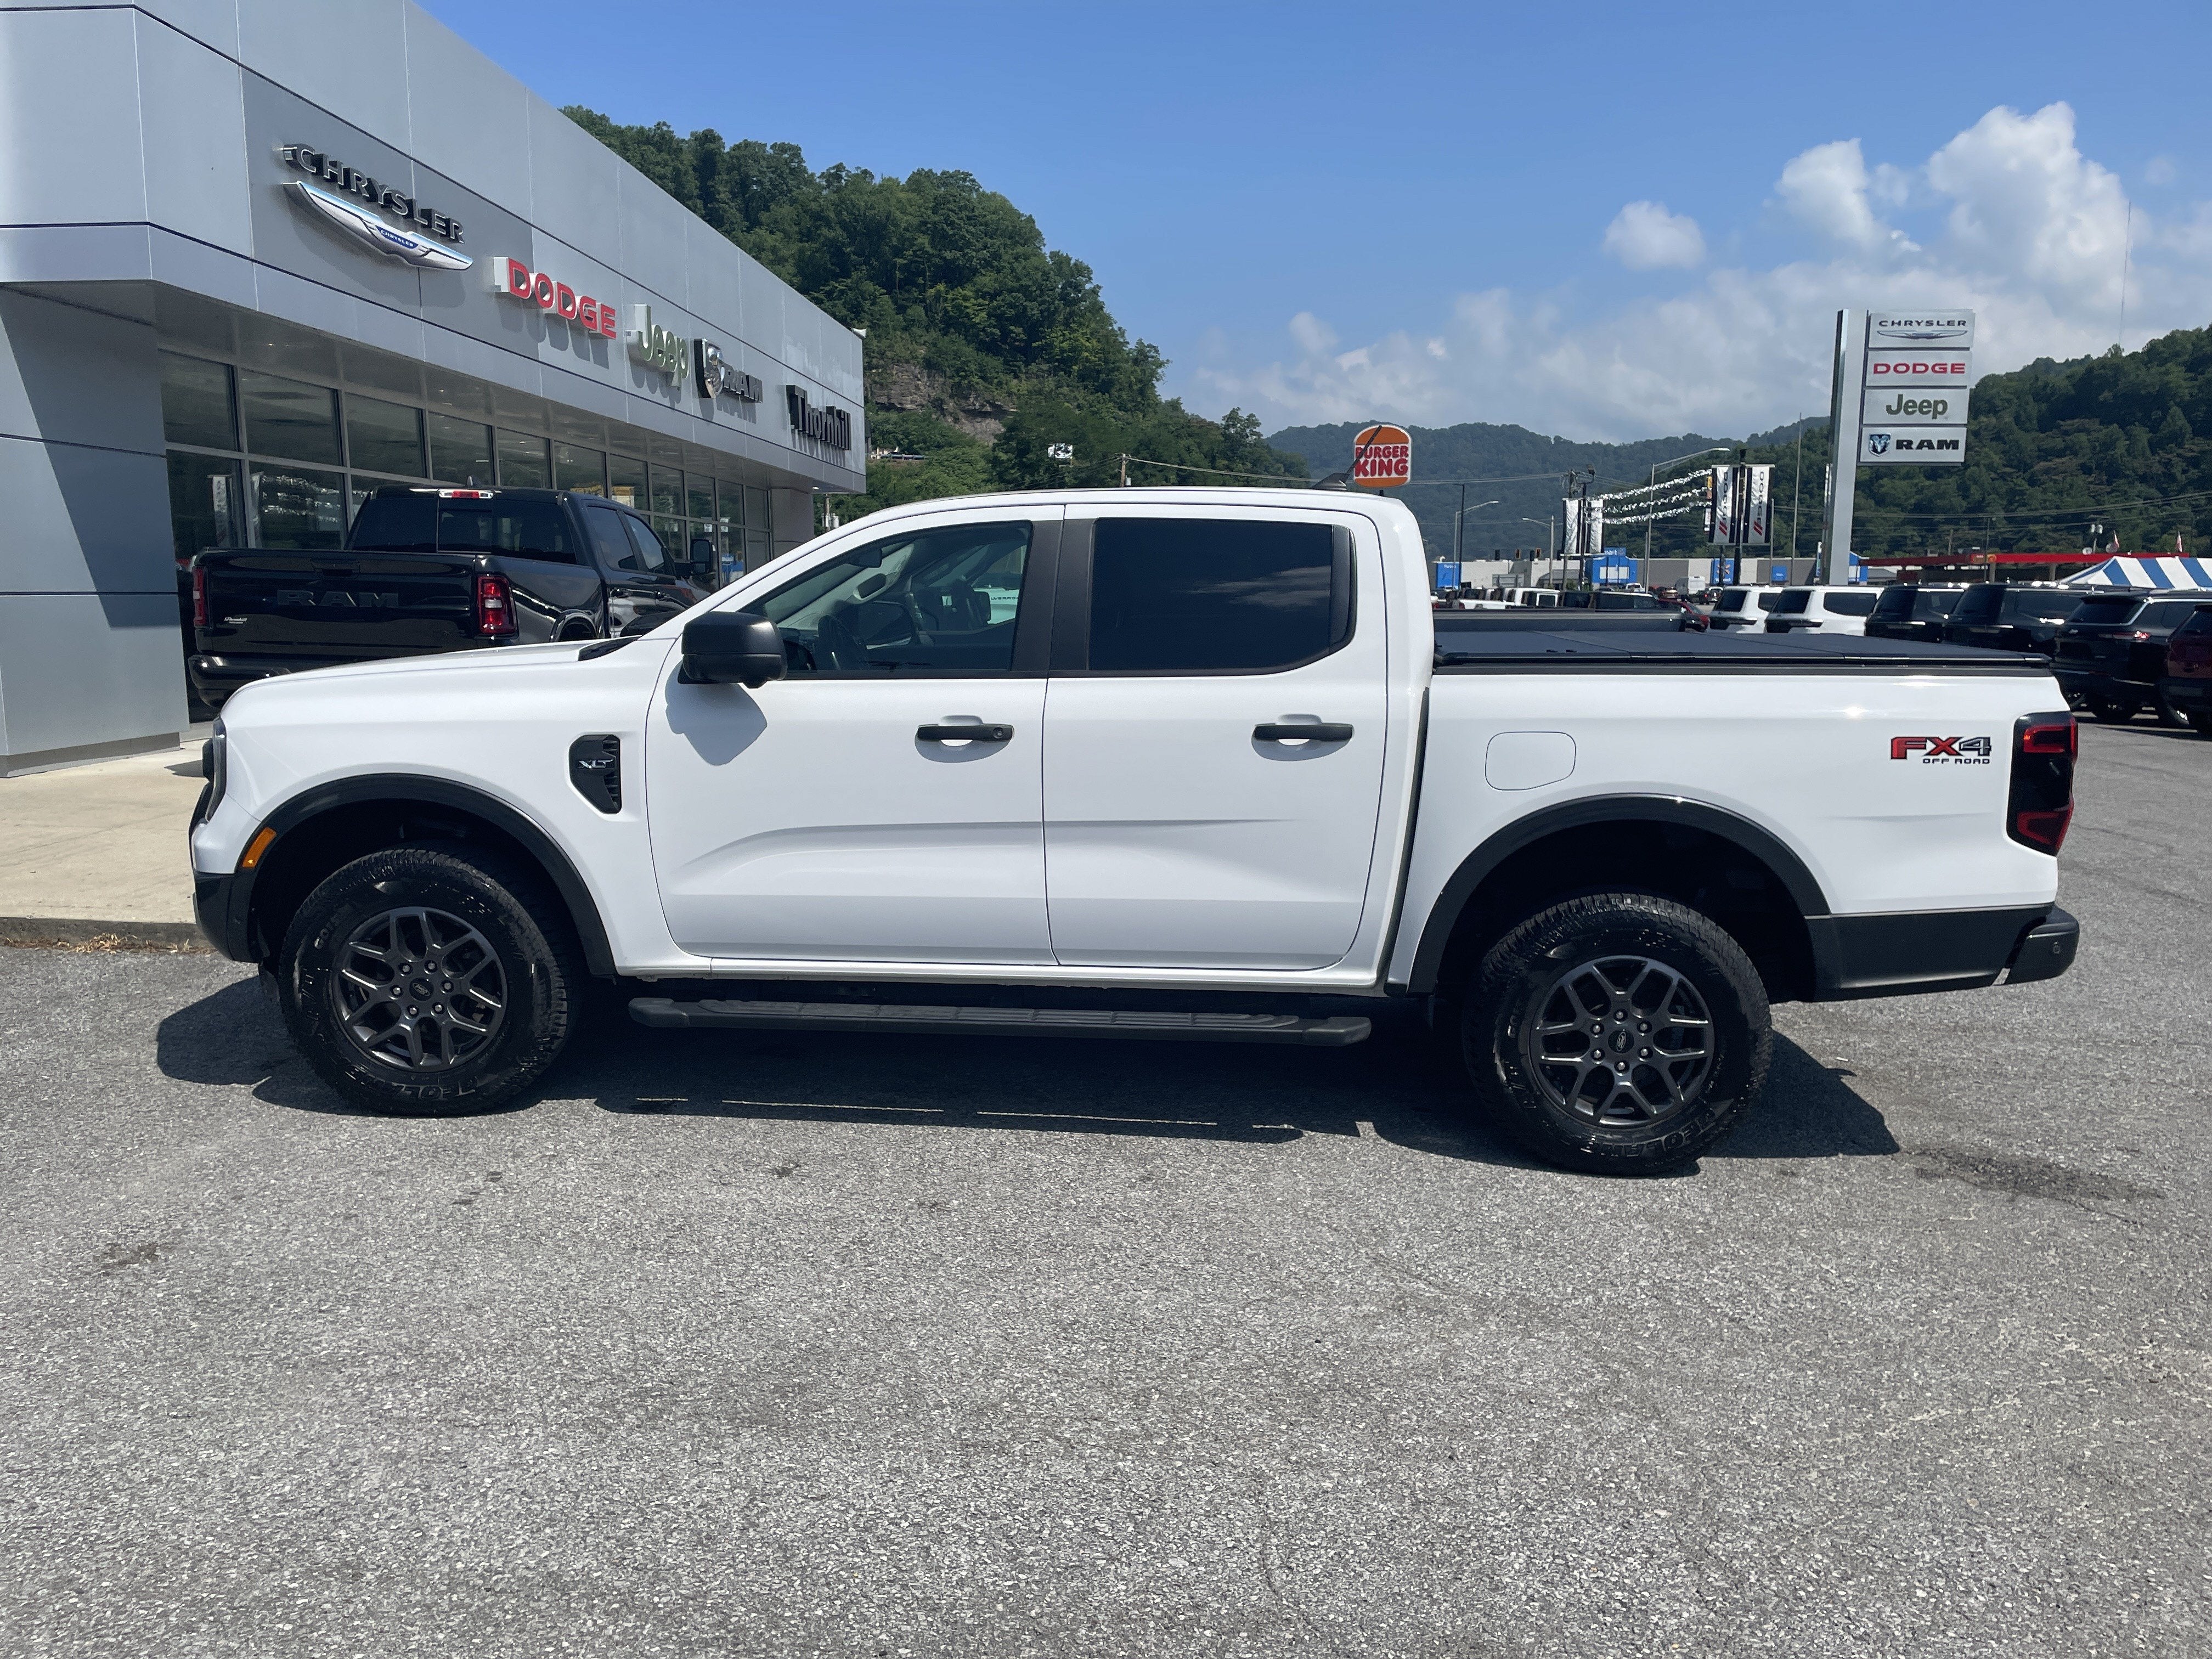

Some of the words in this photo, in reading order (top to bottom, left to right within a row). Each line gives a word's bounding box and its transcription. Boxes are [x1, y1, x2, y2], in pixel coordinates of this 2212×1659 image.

[287, 144, 465, 244] CHRYSLER
[381, 230, 414, 247] CHRYSLER
[501, 257, 617, 339] DODGE
[627, 304, 689, 387] Jeep
[1873, 363, 1966, 374] DODGE
[722, 361, 763, 403] RAM
[1886, 393, 1948, 420] Jeep
[1895, 439, 1960, 450] RAM
[1355, 458, 1408, 477] KING
[277, 590, 398, 608] RAM
[1891, 736, 1992, 760] FX4
